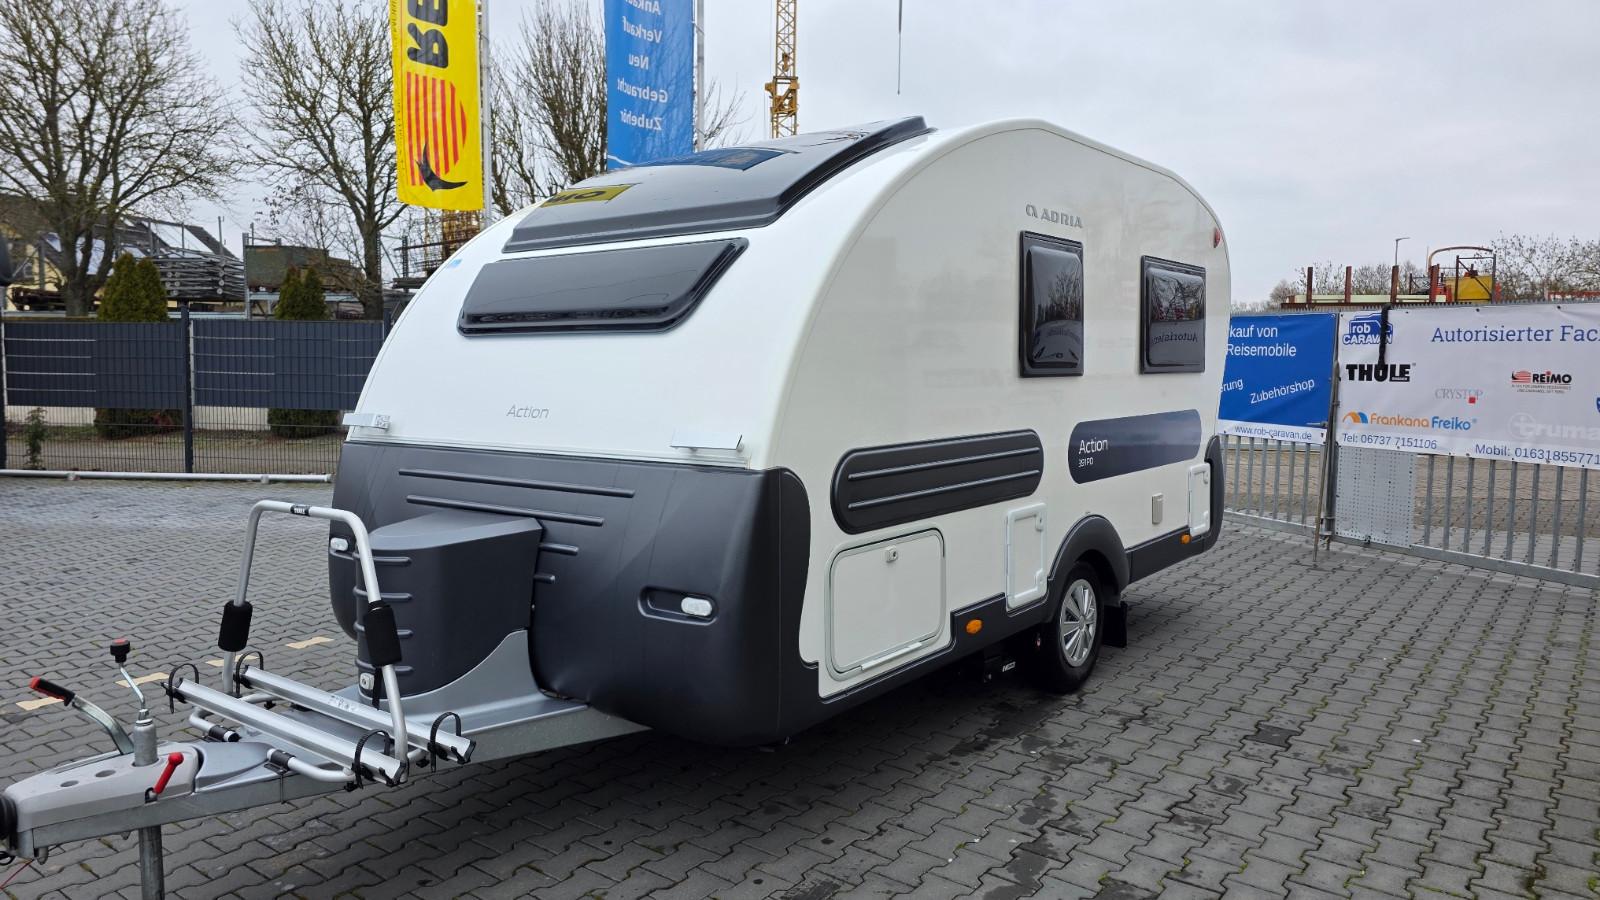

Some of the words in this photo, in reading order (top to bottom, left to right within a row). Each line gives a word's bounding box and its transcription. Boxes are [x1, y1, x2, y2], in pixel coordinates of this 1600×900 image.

[1041, 208, 1083, 228] ADRIA
[1257, 327, 1278, 338] von
[1352, 323, 1371, 334] rob
[1431, 325, 1554, 342] Autorisierter
[1559, 325, 1600, 342] Fac
[1227, 343, 1297, 357] Reisemobile
[1346, 364, 1411, 382] THULE
[1250, 379, 1316, 404] Zubehörshop
[506, 404, 550, 419] Action
[1370, 413, 1430, 428] Frankana
[1431, 416, 1471, 431] Freiko
[1234, 425, 1313, 440] www.rob-caravan.de
[1078, 436, 1109, 454] Action
[1342, 432, 1358, 443] Tel:
[1360, 434, 1391, 445] 06737
[1395, 436, 1437, 449] 7151106
[1475, 443, 1510, 457] Mobil:
